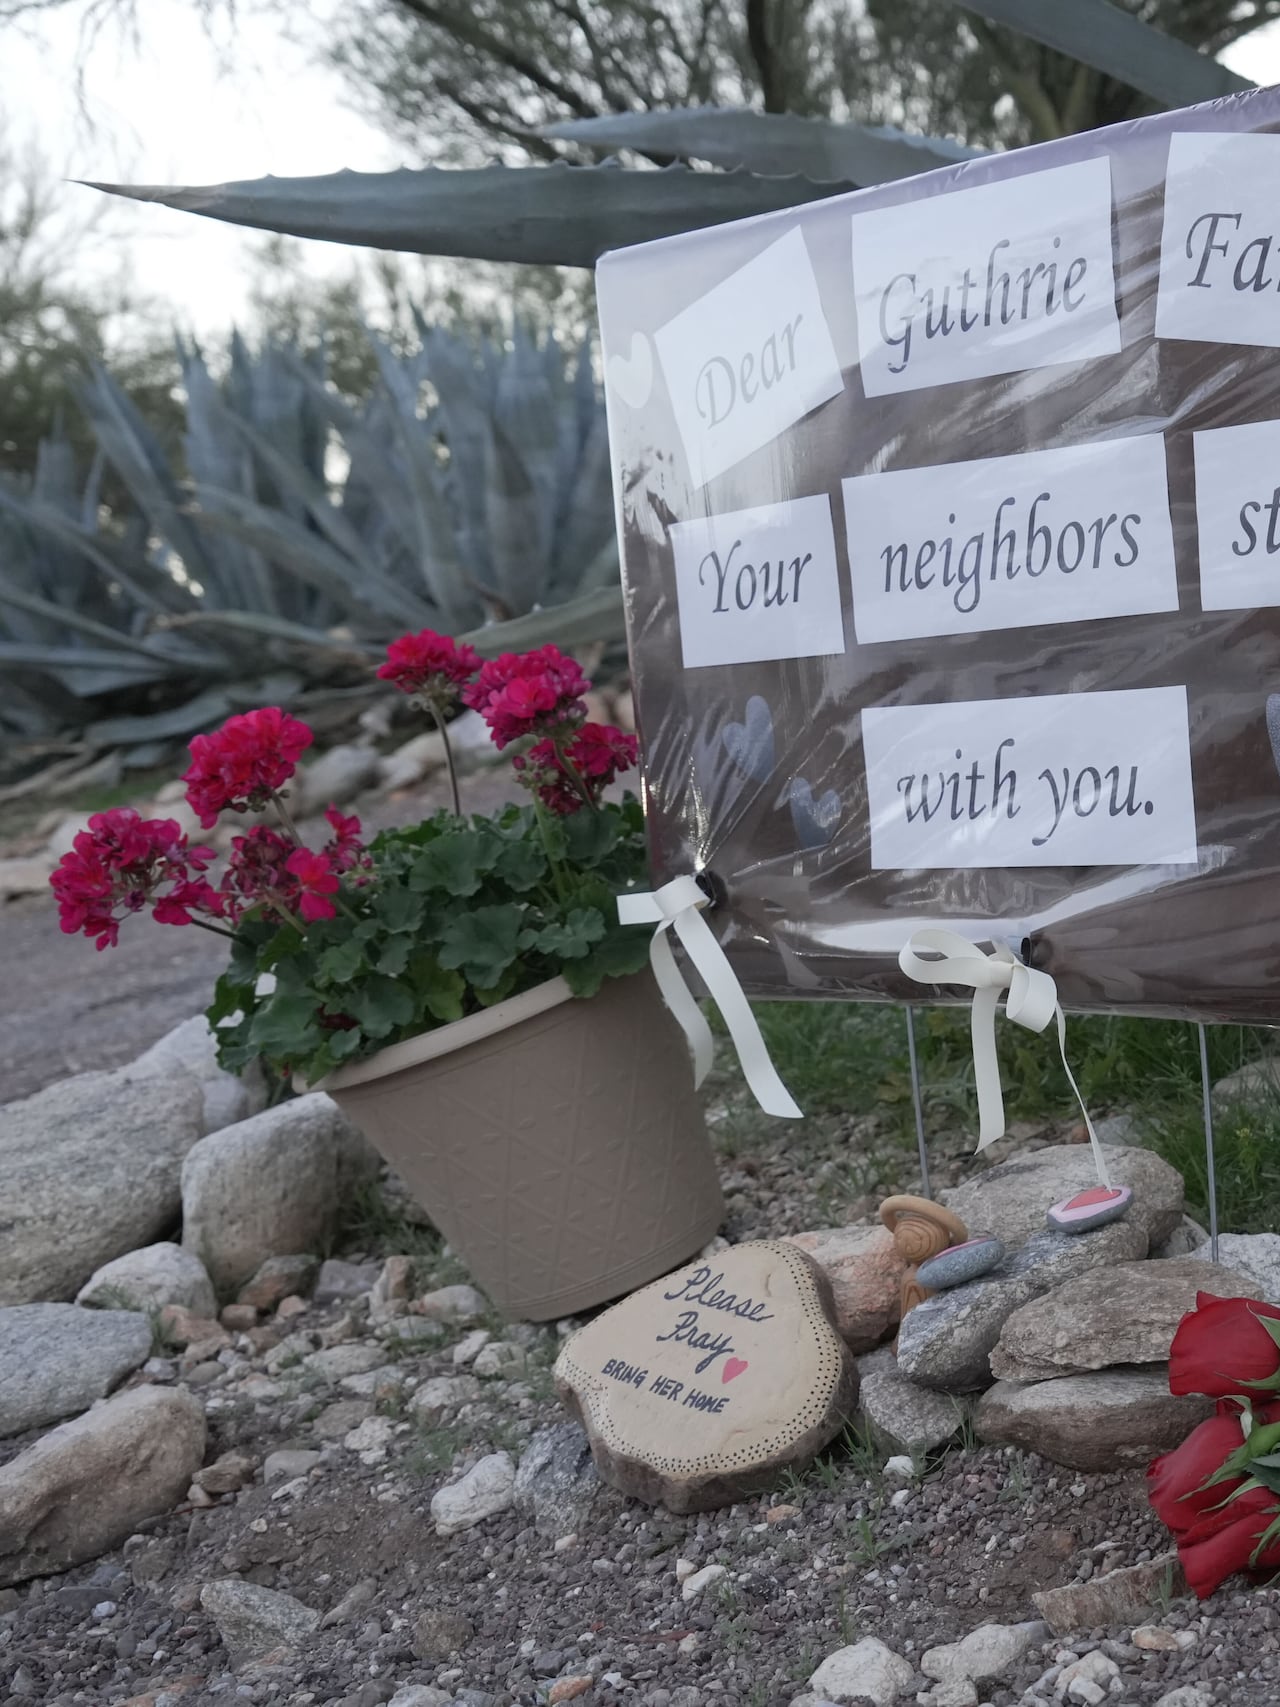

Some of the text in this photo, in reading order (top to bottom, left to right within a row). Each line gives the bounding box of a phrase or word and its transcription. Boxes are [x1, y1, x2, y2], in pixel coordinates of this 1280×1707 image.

[695, 314, 803, 430] Dear
[878, 236, 1087, 373] Guthrie
[699, 540, 812, 613] Your
[880, 492, 1141, 613] neighbors
[897, 738, 1154, 846] with you.
[664, 1264, 774, 1322] Please
[656, 1311, 734, 1374] Pray
[601, 1358, 730, 1413] BRING HER HOME
